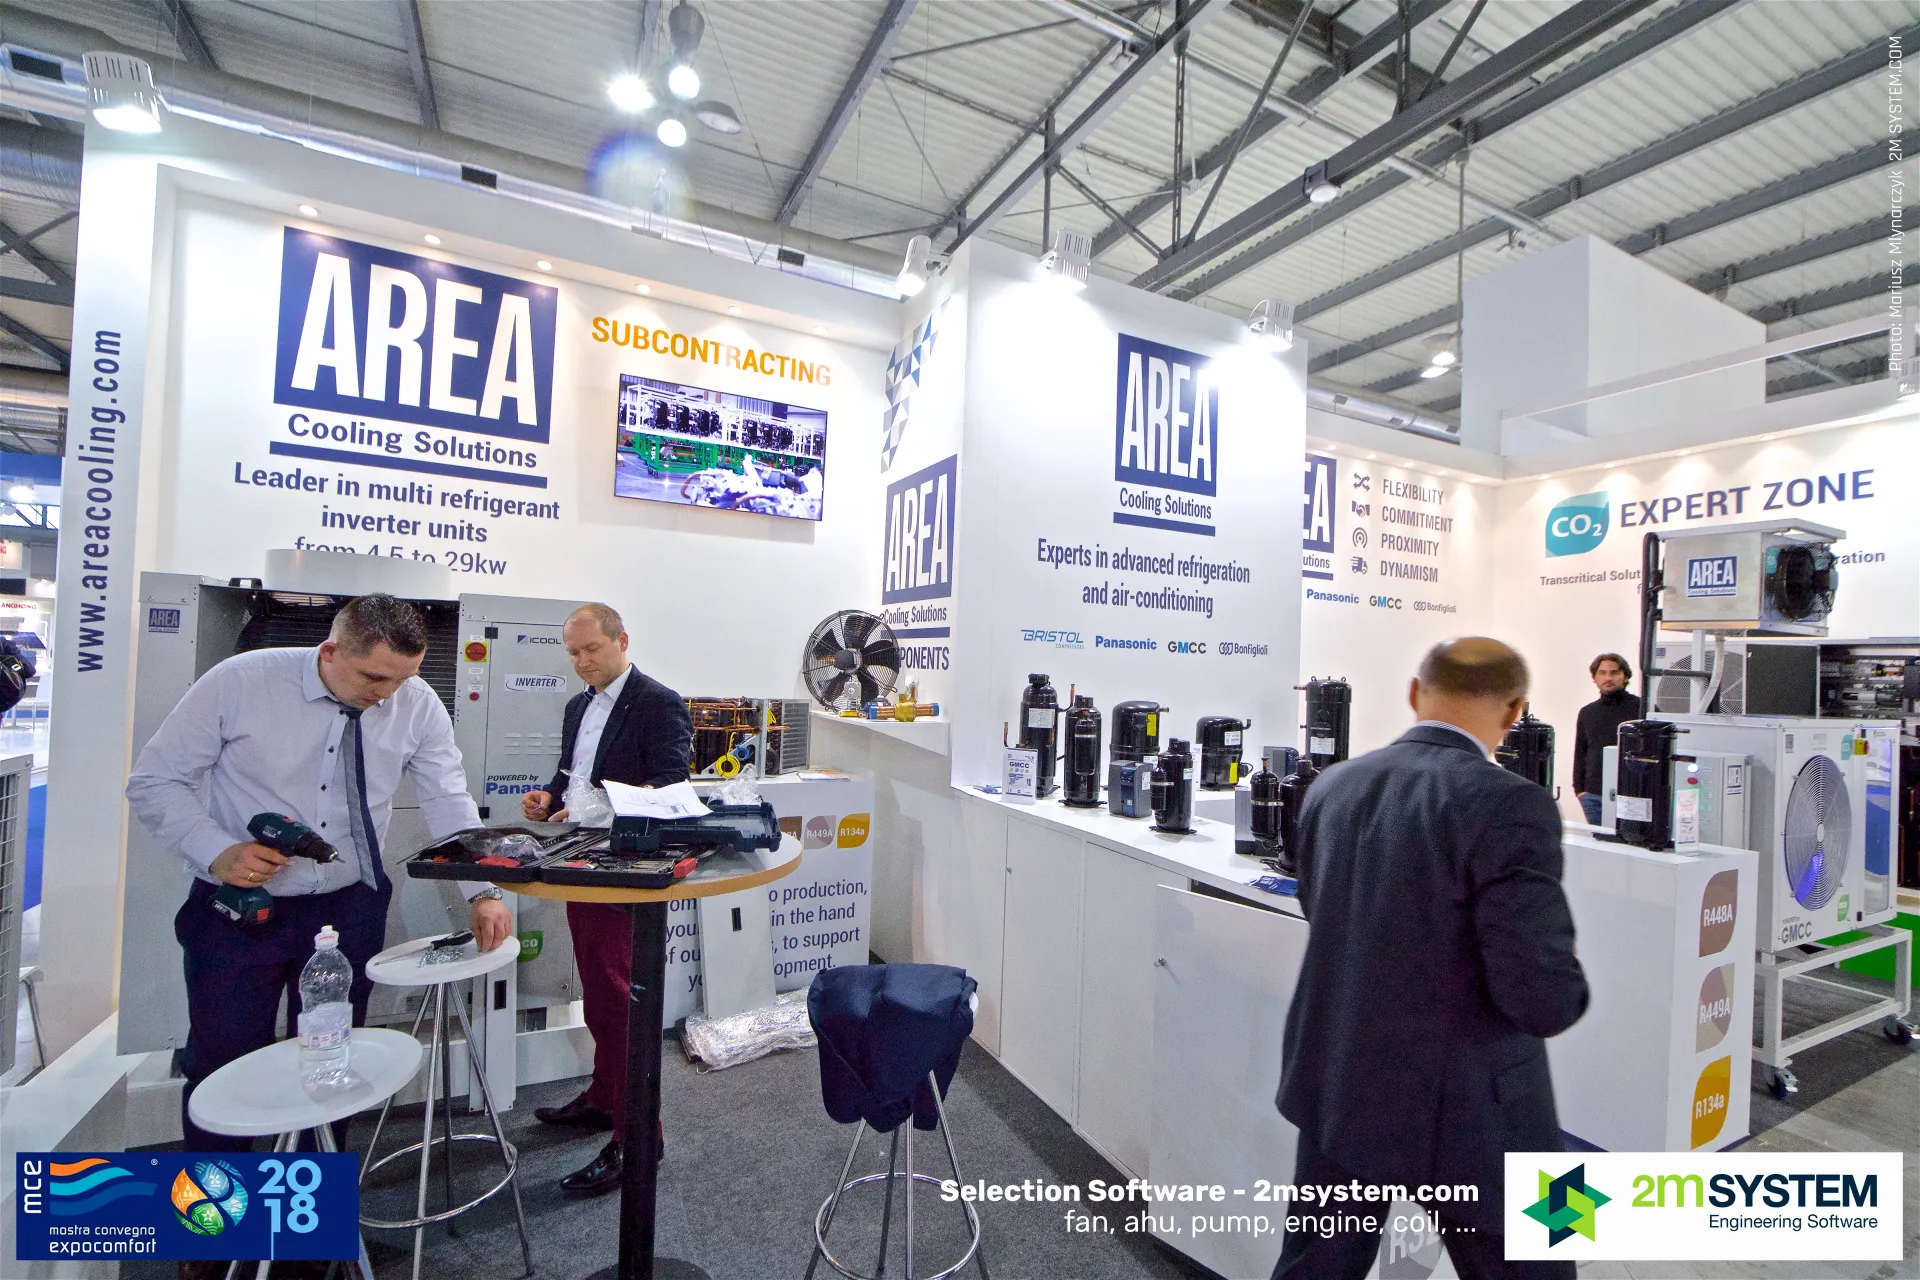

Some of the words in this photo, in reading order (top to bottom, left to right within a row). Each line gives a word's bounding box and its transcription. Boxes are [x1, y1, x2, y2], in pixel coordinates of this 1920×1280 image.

[291, 252, 538, 427] AREA
[592, 316, 831, 387] SUBCONTRACTING
[1121, 351, 1212, 482] AREA
[288, 413, 402, 453] Cooling
[414, 431, 537, 469] Solutions
[77, 330, 126, 673] www.areacooling.com
[235, 462, 329, 494] Leader
[336, 475, 360, 497] in
[368, 478, 433, 507] multi
[440, 483, 560, 521] refrigerant
[1120, 487, 1162, 515] Cooling
[1165, 494, 1212, 520] Solutions
[1383, 478, 1444, 505] FLEXIBILITY
[1621, 486, 1751, 527] EXPERT
[1763, 469, 1874, 511] ZONE
[321, 505, 421, 538] inverter
[428, 513, 488, 544] units
[1382, 505, 1453, 533] COMMITMENT
[885, 473, 951, 592] AREA
[1381, 533, 1439, 557] PROXIMITY
[444, 551, 507, 576] 29kw
[1037, 538, 1092, 569] Experts
[1096, 543, 1108, 566] in
[1112, 545, 1174, 575] advanced
[1178, 555, 1250, 585] refrigeration
[1302, 554, 1330, 569] utions
[1380, 560, 1438, 583] DYNAMISM
[1540, 570, 1607, 586] Transcritical
[1610, 569, 1641, 581] Solut
[1834, 549, 1886, 565] ration
[1690, 559, 1735, 587] AREA
[1082, 580, 1108, 605] and
[1112, 583, 1213, 618] air-conditioning
[1306, 588, 1360, 605] Panasonic
[1369, 595, 1402, 610] GMCC
[151, 609, 179, 627] AREA
[884, 607, 909, 628] Cooling
[911, 604, 947, 623] Solutions
[1021, 629, 1084, 643] BRISTOL
[1095, 635, 1157, 650] Panasonic
[1168, 641, 1207, 654] GMCC
[1234, 642, 1268, 657] Bonfiglioli
[899, 646, 950, 671] PONENTS
[515, 677, 557, 687] INVERTER
[1009, 761, 1030, 769] GMCC
[487, 774, 528, 782] POWERED
[529, 774, 539, 783] by
[806, 829, 833, 839] R449A
[840, 827, 865, 837] R134a
[783, 881, 868, 905] production,
[771, 911, 785, 927] in
[790, 907, 814, 926] the
[819, 902, 855, 922] hand
[1703, 904, 1733, 928] R448A
[521, 938, 538, 948] CO
[666, 923, 699, 943] you
[783, 935, 798, 950] to
[803, 927, 860, 948] support
[1781, 921, 1812, 944] GMCC
[774, 953, 836, 979] opment.
[1699, 998, 1731, 1025] R449A
[1695, 1093, 1725, 1119] R134a
